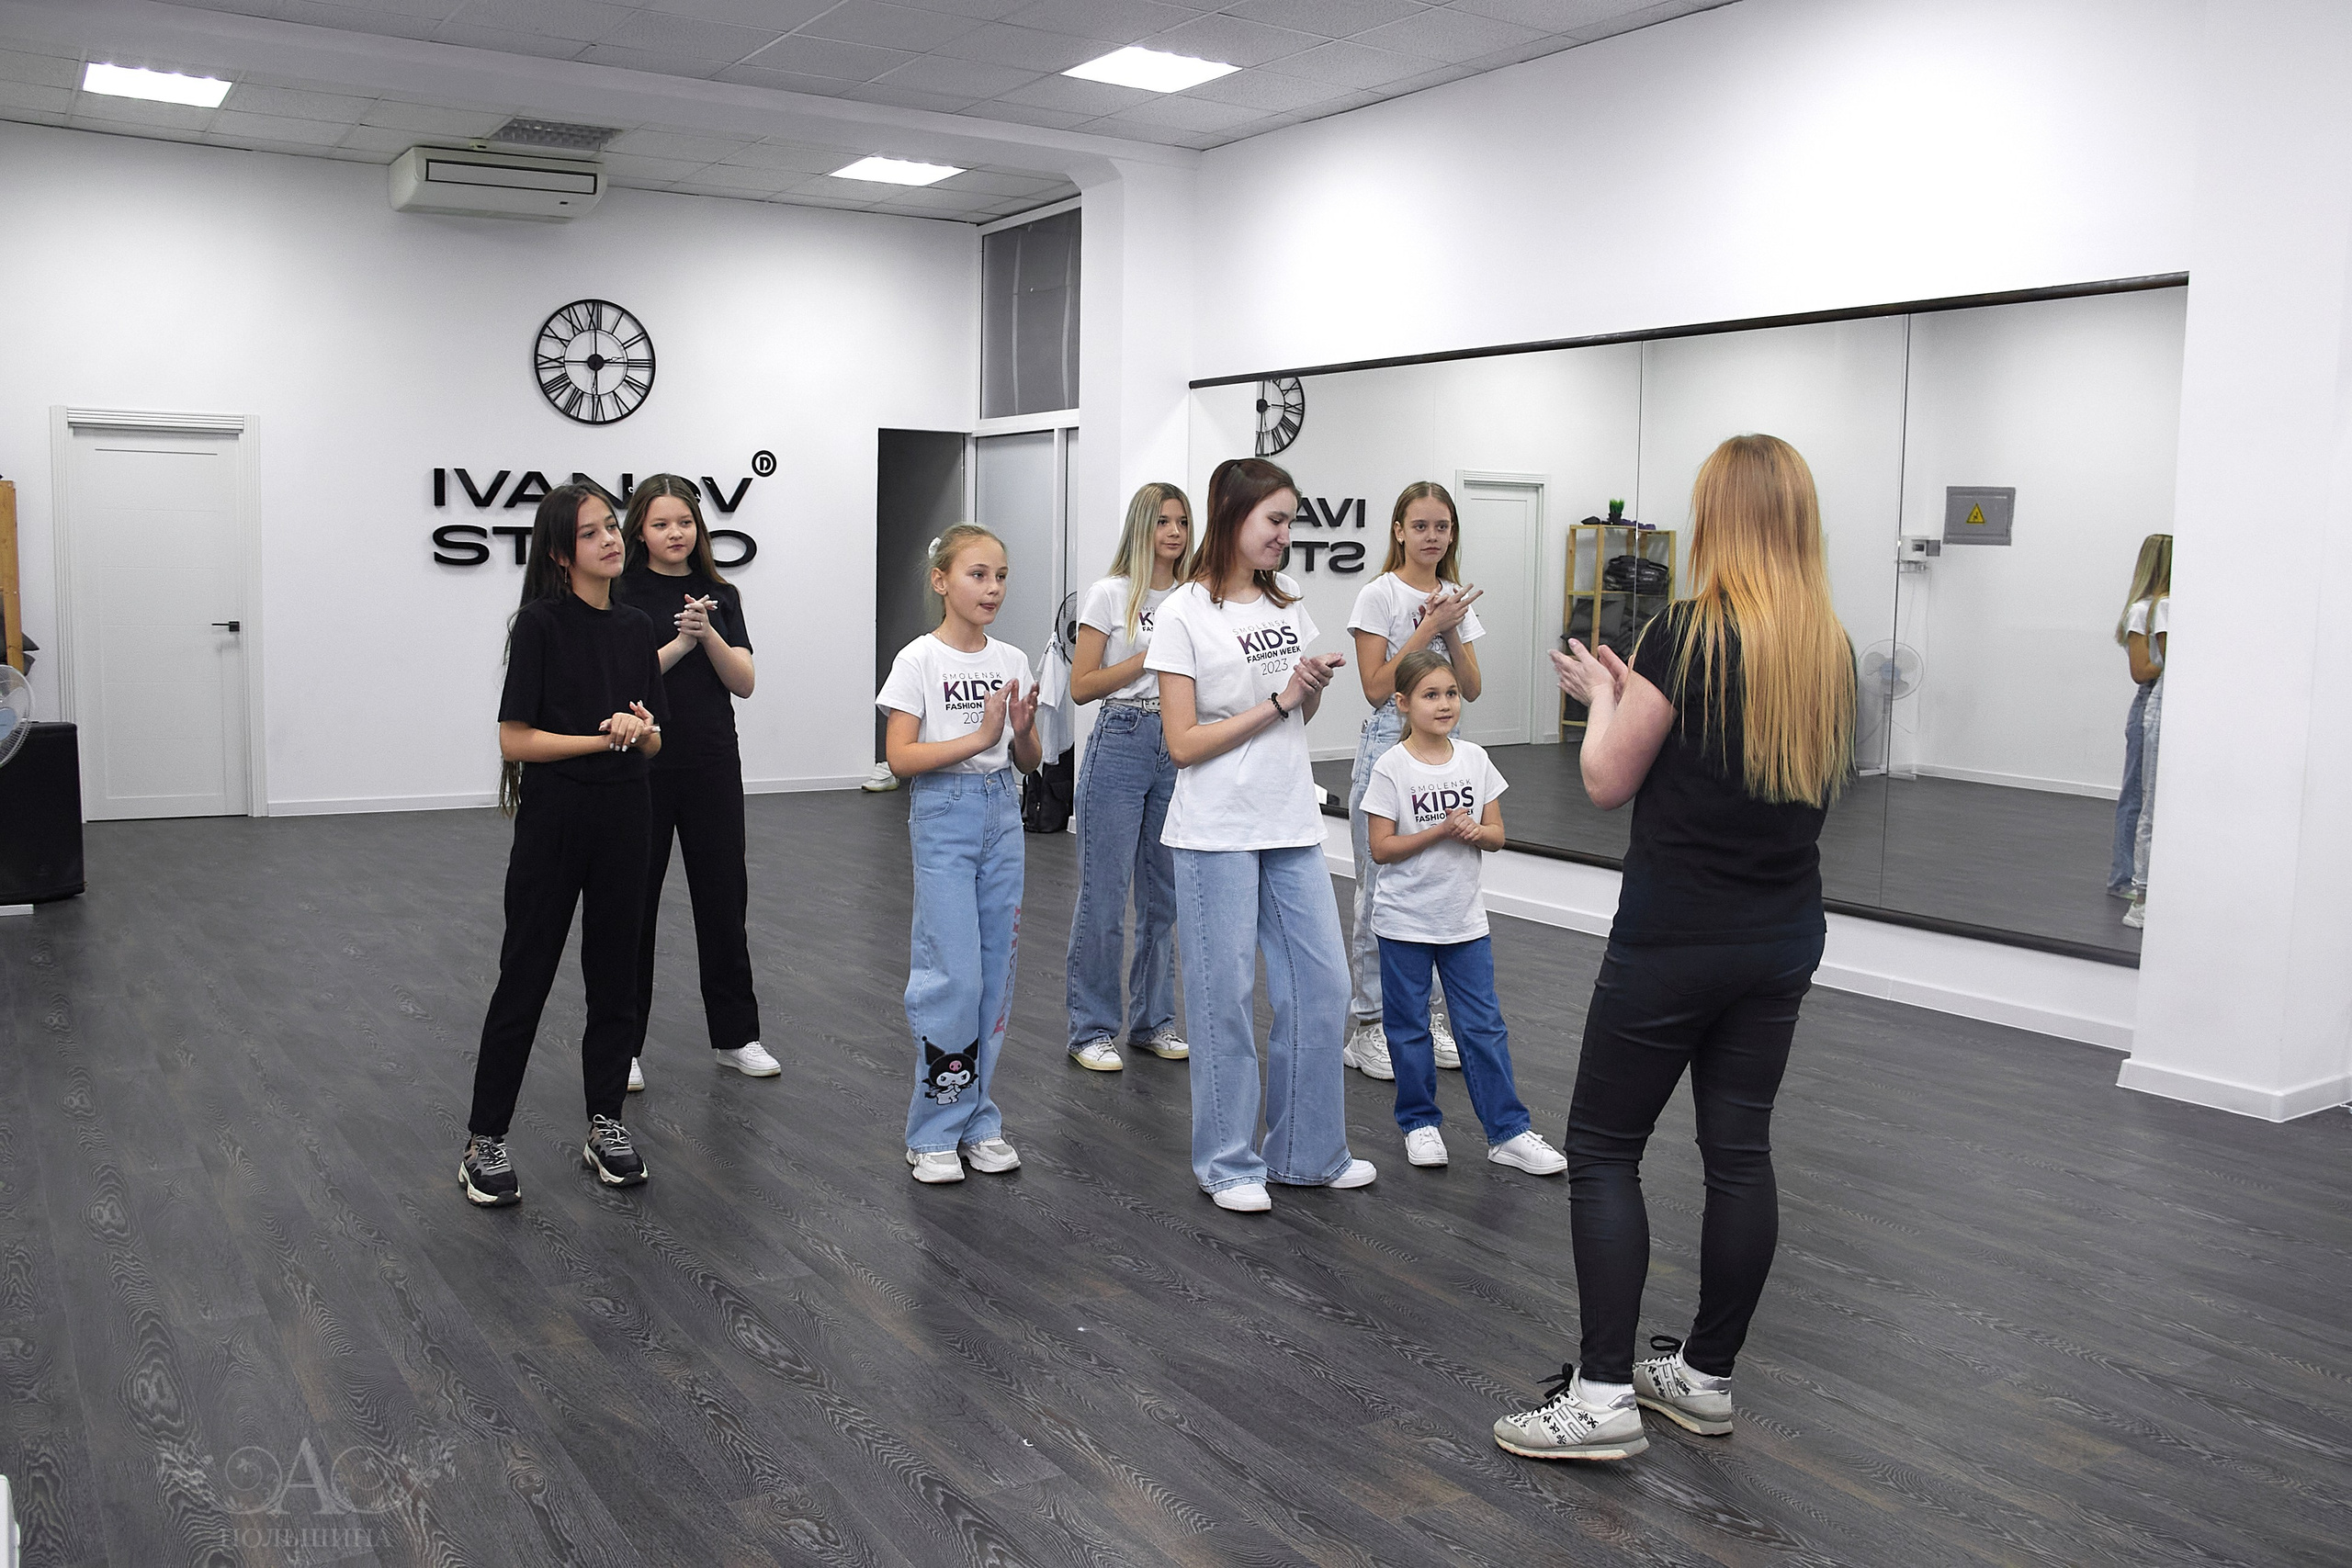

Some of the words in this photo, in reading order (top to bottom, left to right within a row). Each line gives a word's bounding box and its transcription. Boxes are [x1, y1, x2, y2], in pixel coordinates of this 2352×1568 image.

[433, 468, 753, 513] IVANV
[1232, 619, 1288, 636] SMOLENSK
[1237, 626, 1298, 655] KIDS
[1247, 649, 1278, 663] FASHION
[1280, 645, 1302, 658] WEEK
[1261, 658, 1289, 676] 2023
[942, 671, 1001, 681] SMOLENSK
[945, 701, 983, 711] FASHION
[1410, 778, 1472, 794] SMOLENSK
[1411, 786, 1475, 816] KIDS
[1415, 812, 1447, 824] FASHIO
